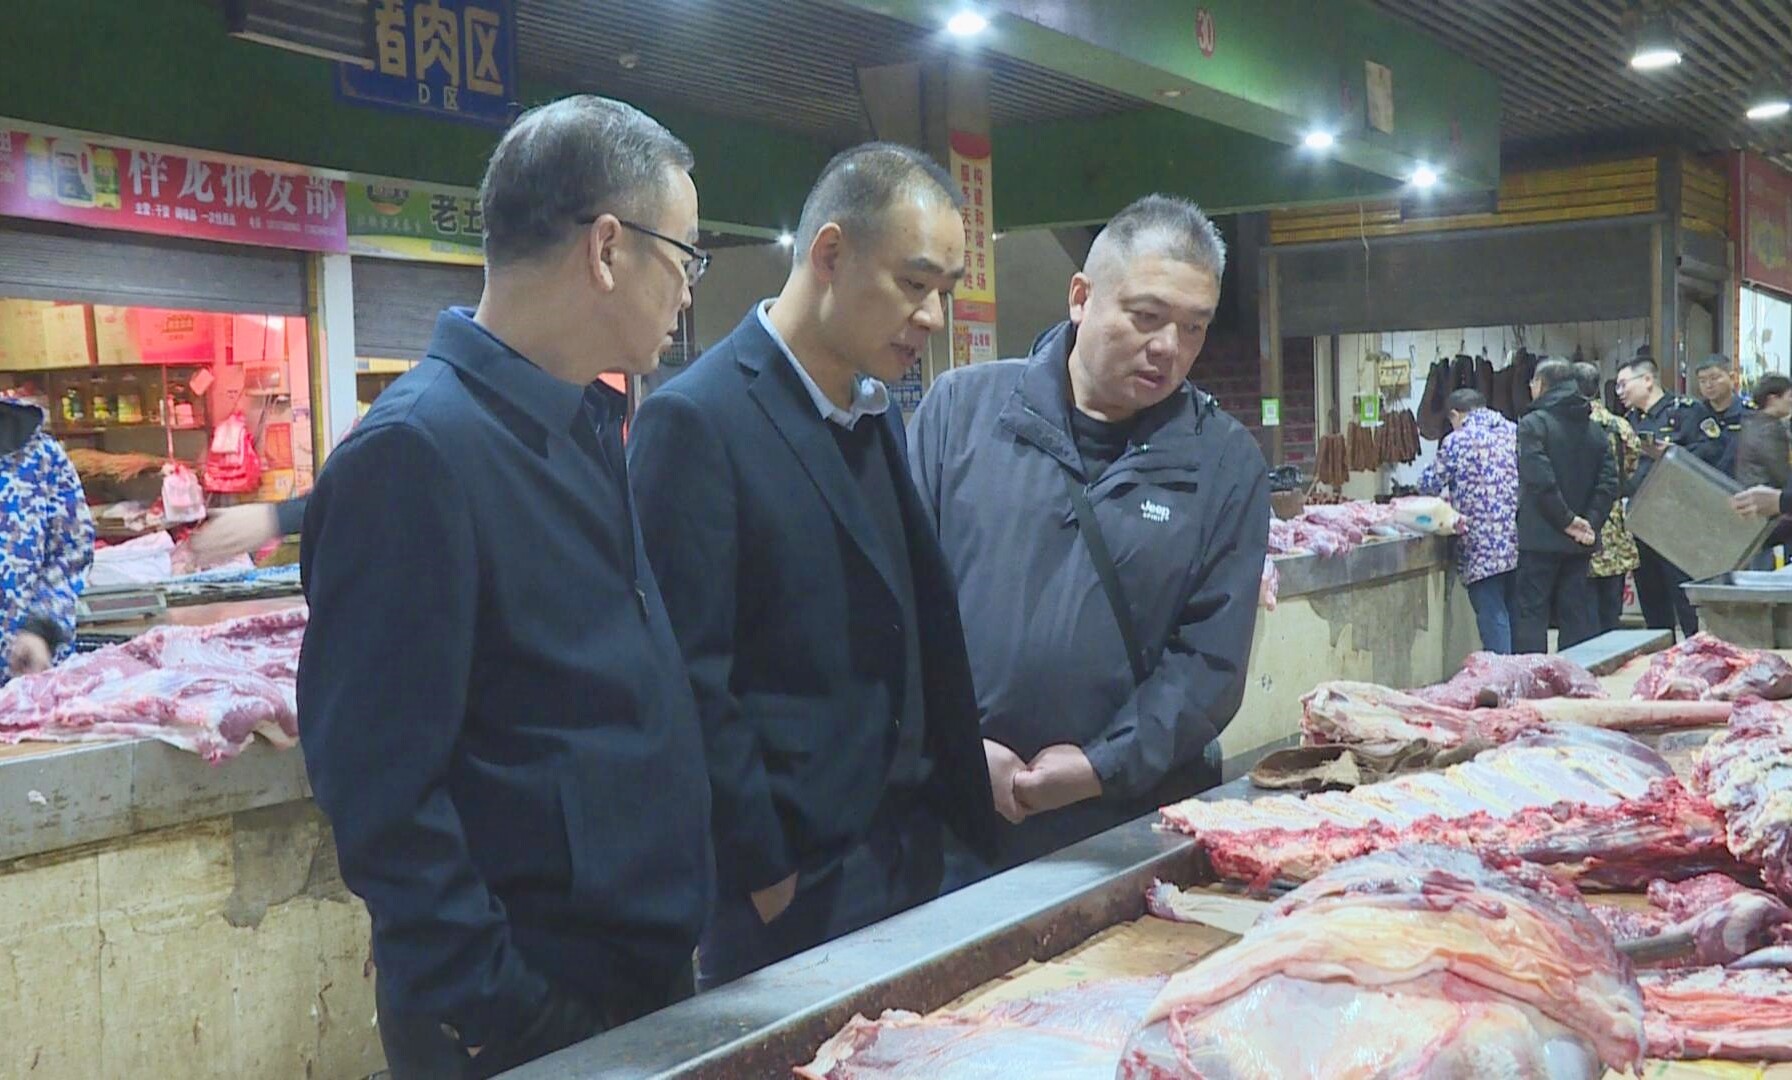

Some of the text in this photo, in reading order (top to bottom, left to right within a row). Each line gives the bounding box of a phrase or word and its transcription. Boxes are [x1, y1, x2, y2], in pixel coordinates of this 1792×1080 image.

[1198, 9, 1215, 52] 30
[418, 83, 431, 104] D
[1140, 499, 1170, 521] Jeep
